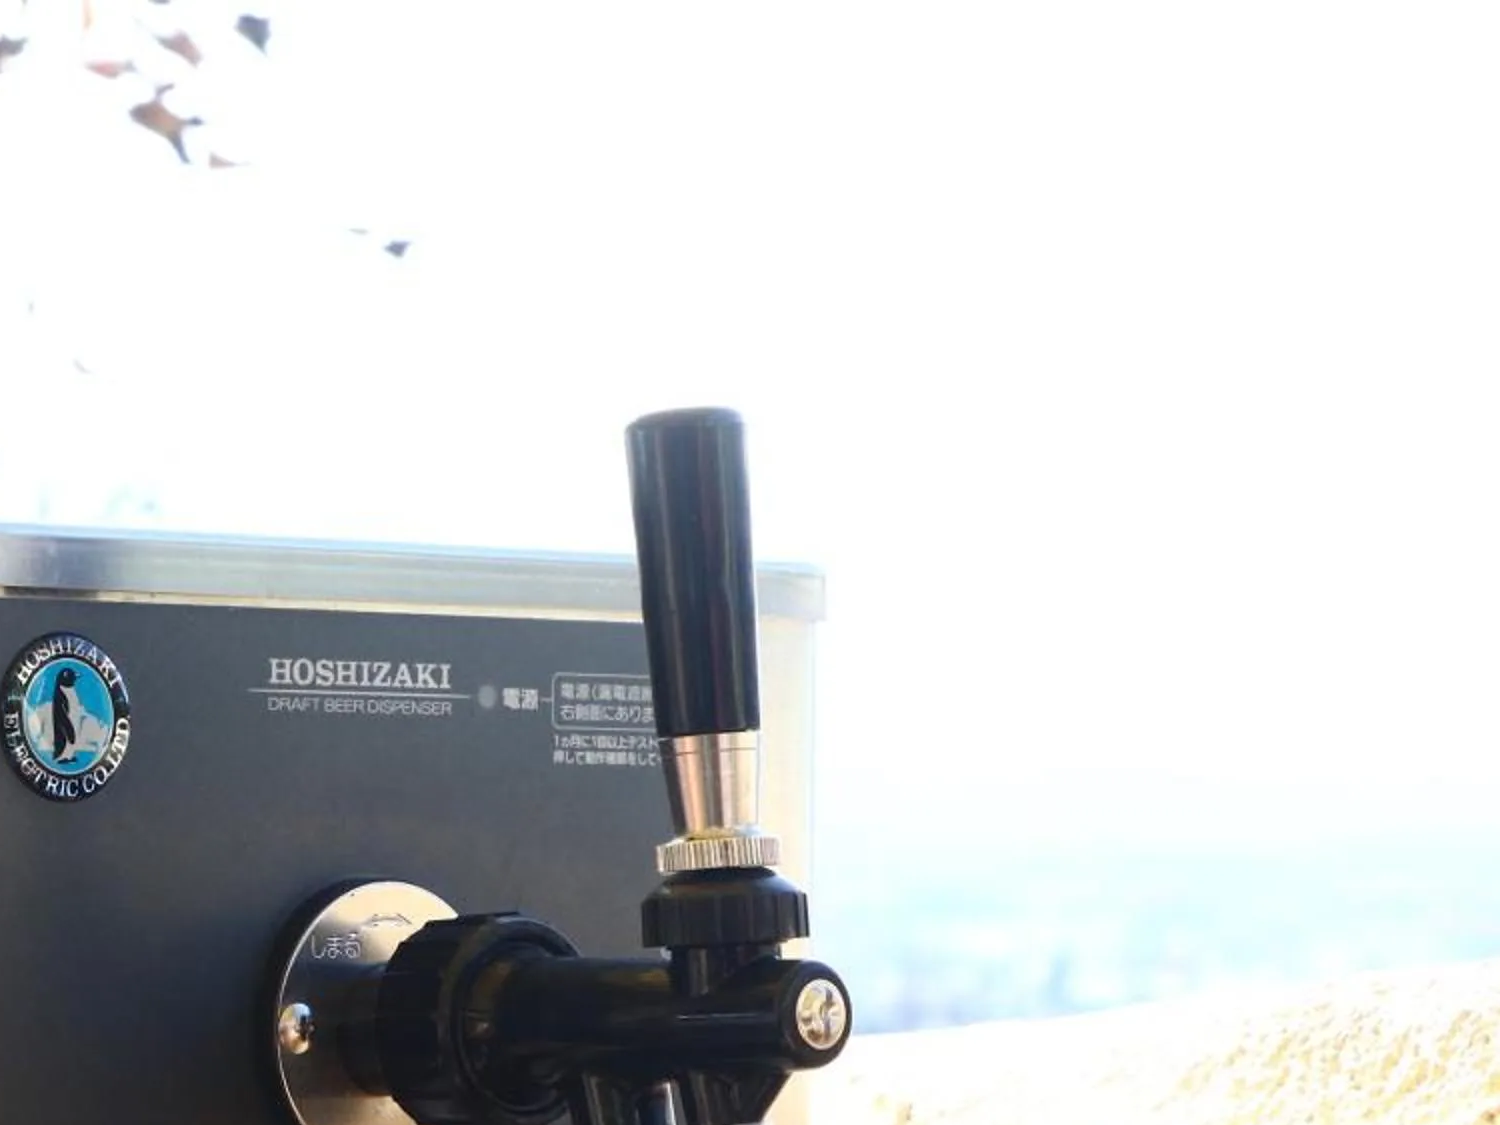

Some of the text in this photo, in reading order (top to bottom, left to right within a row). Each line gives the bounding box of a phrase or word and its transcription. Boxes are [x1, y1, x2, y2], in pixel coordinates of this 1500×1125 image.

[16, 636, 123, 687] HOSHIZAKI
[268, 658, 452, 690] HOSHIZAKI
[268, 697, 452, 716] DRAFT BEER DISPENSER
[503, 687, 539, 710] 電源
[311, 931, 361, 959] しまる
